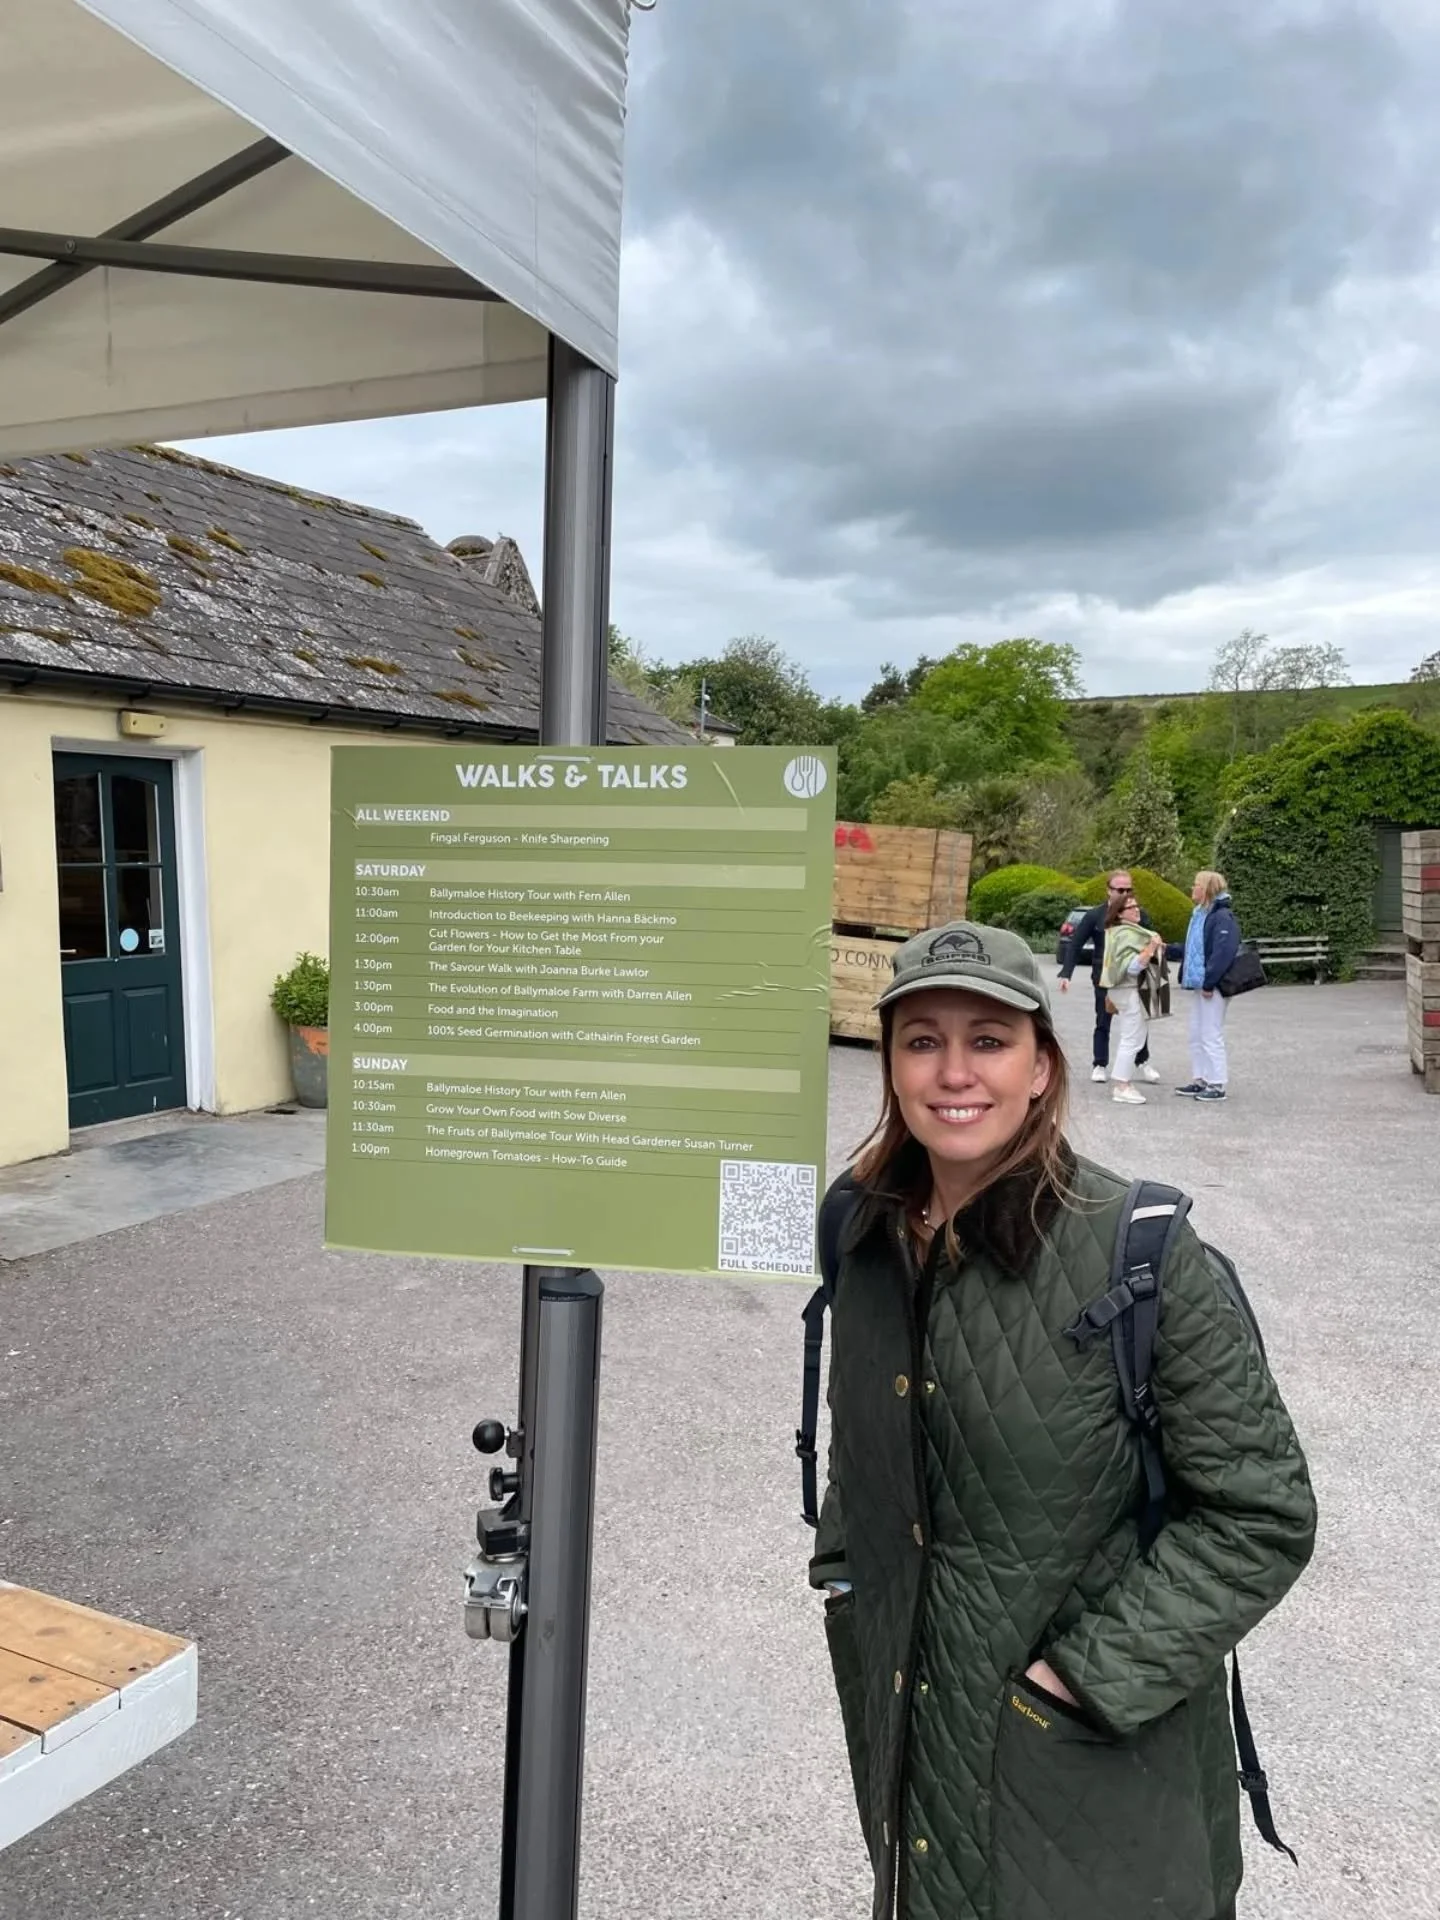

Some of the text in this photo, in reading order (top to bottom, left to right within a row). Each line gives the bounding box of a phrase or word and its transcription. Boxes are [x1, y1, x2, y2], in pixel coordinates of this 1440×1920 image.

[456, 764, 689, 790] WALKS & TALKS
[356, 809, 450, 822] ALL WEEKEND
[430, 833, 462, 844] Fingal
[463, 833, 510, 845] Ferguson
[522, 834, 548, 843] Knife
[550, 834, 609, 847] Sharpening
[355, 864, 426, 878] SATURDAY
[355, 887, 399, 896] 10:30am
[430, 888, 630, 901] Ballymaloe History Tour with Fern Allen
[356, 908, 398, 919] 11:00am
[429, 909, 493, 920] Introduction
[495, 912, 507, 920] to
[509, 911, 569, 924] Beekeeping
[571, 912, 594, 922] with
[597, 914, 632, 923] Hanna
[355, 933, 399, 945] 12:00pm
[429, 929, 447, 938] Cut
[450, 929, 489, 940] Flowers
[500, 930, 525, 941] How
[527, 932, 538, 940] to
[541, 931, 559, 941] Get
[562, 932, 579, 941] the
[582, 932, 608, 942] Most
[610, 933, 637, 943] From
[639, 936, 664, 946] your
[429, 942, 581, 955] Garden for Your Kitchen Table
[355, 959, 392, 971] 1:30pm
[428, 961, 649, 977] The Savour Walk with Joanna Burke Lawlor
[355, 981, 392, 992] 1:30pm
[427, 983, 692, 1001] The Evolution of Ballymaloe Farm with Darren Allen
[428, 1004, 558, 1018] Food and the Imagination
[428, 1025, 455, 1036] 100%
[457, 1026, 483, 1036] Seed
[484, 1027, 549, 1039] Germination
[550, 1031, 574, 1040] with
[626, 1032, 659, 1044] Forest
[661, 1034, 700, 1045] Garden
[353, 1058, 408, 1071] SUNDAY
[353, 1080, 395, 1090] 10:15am
[427, 1083, 626, 1101] Ballymaloe History Tour with Fern Allen
[352, 1100, 396, 1112] 10:30am
[426, 1104, 627, 1122] Grow Your Own Food with Sow Diverse
[352, 1122, 394, 1132] 11:30am
[426, 1125, 754, 1151] The Fruits of Ballymaloe Tour With Head Gardener Susan Turner
[426, 1146, 489, 1160] Homegrown
[492, 1150, 541, 1162] Tomatoes
[552, 1154, 593, 1165] How-To
[596, 1156, 627, 1168] Guide
[720, 1258, 813, 1274] FULL SCHEDULE
[1011, 1695, 1051, 1729] Barbour
